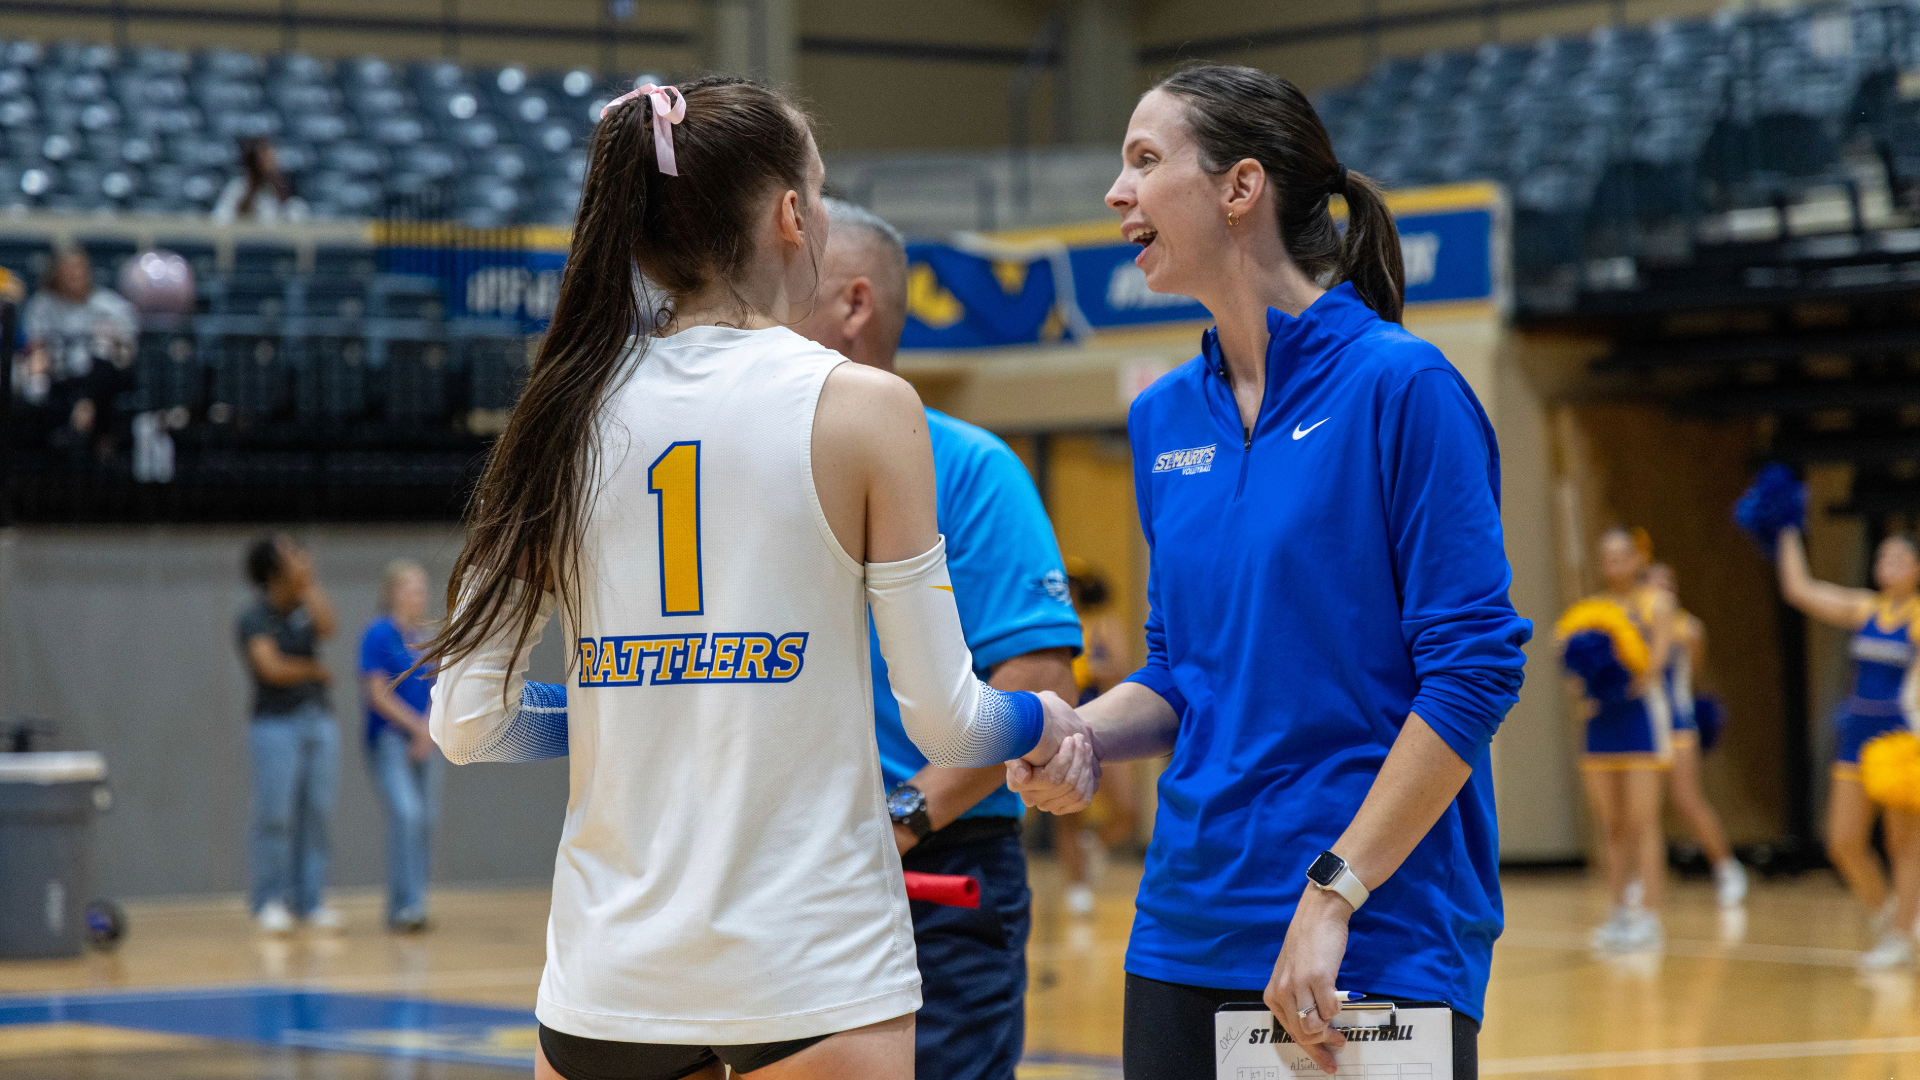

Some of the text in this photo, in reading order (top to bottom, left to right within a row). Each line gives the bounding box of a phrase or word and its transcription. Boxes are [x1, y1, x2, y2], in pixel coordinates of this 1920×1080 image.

[648, 440, 704, 617] 1
[578, 632, 809, 687] RATTLERS
[1248, 1028, 1270, 1044] ST
